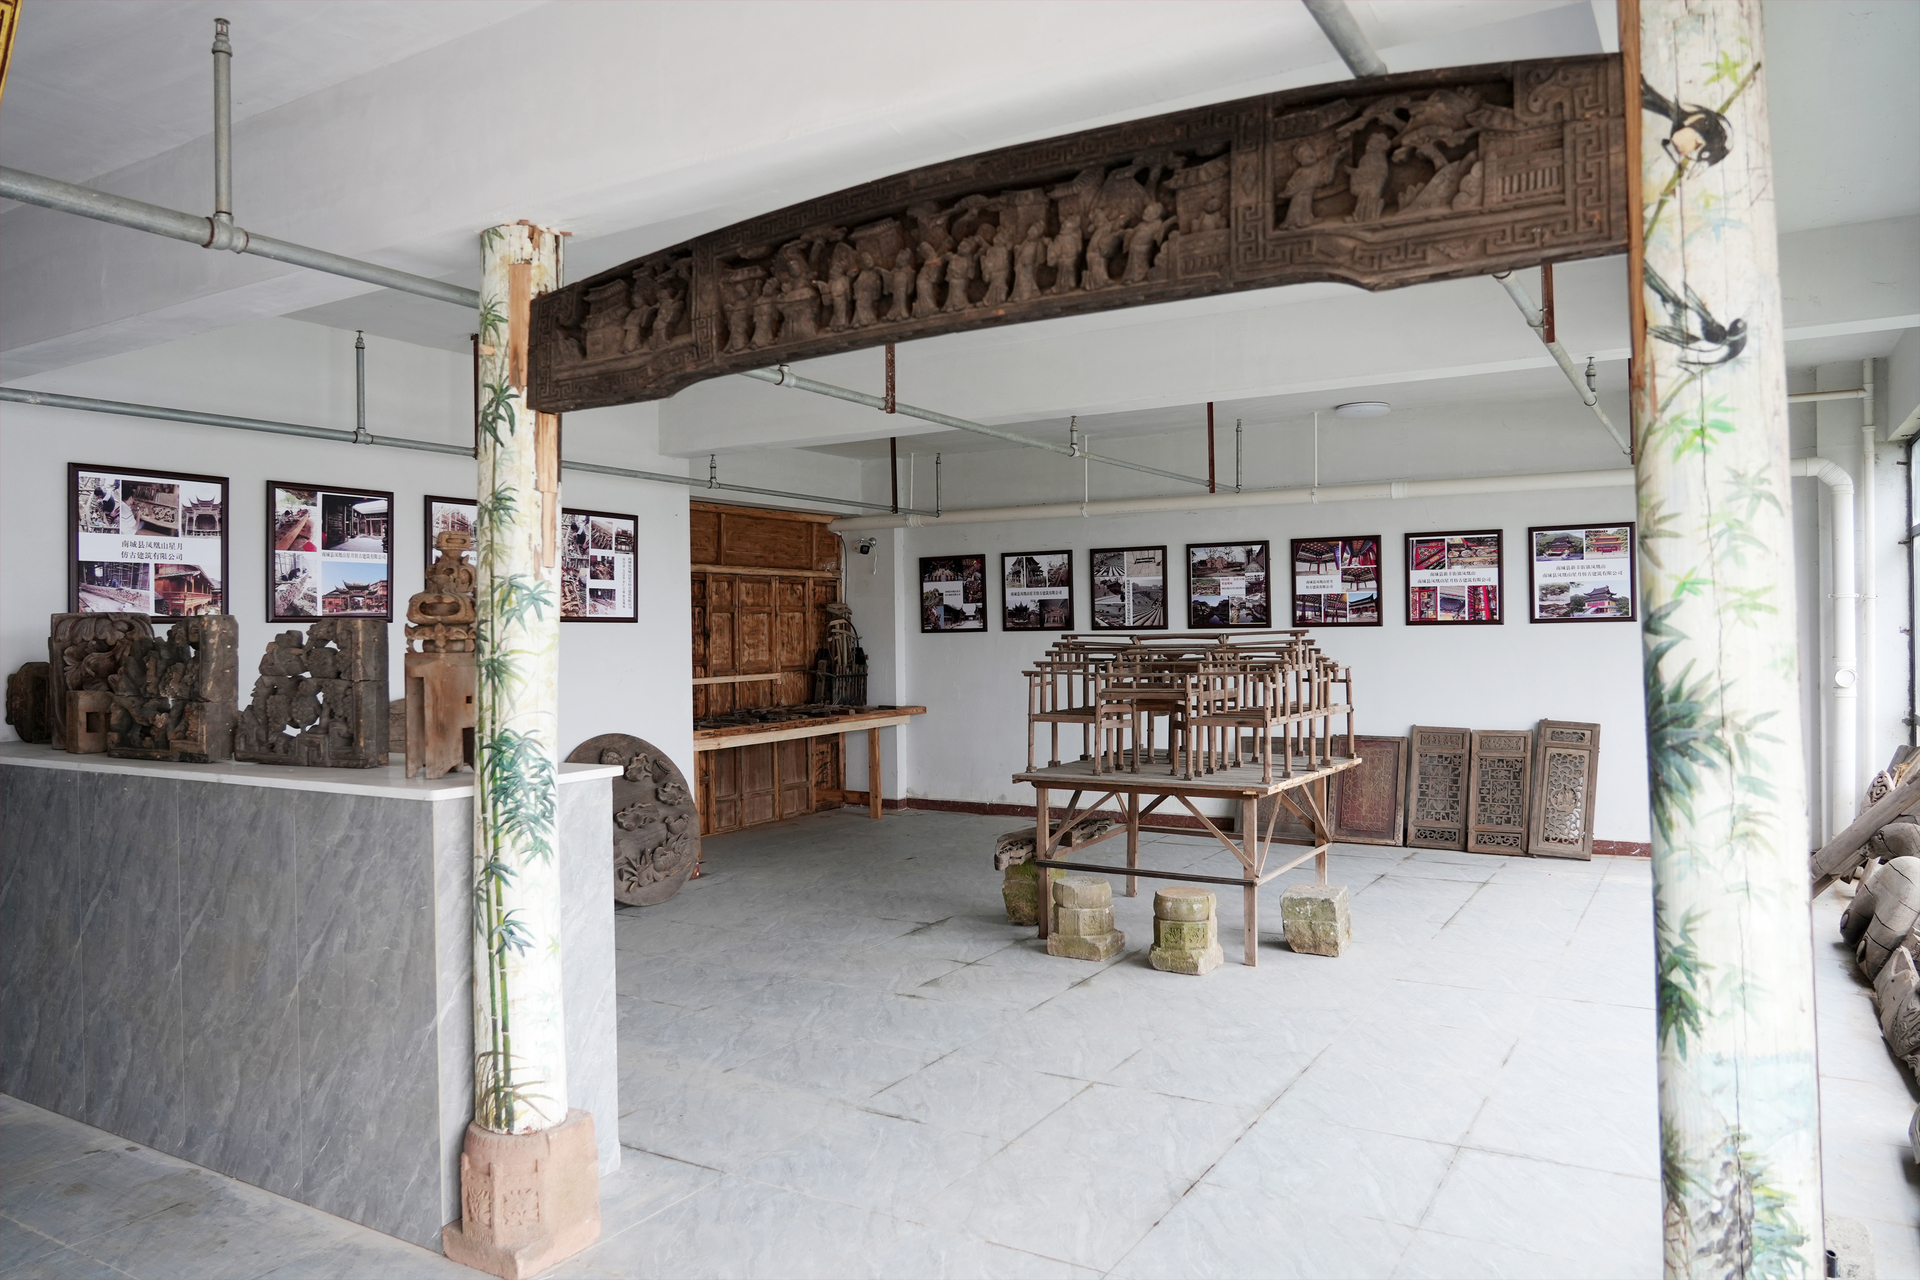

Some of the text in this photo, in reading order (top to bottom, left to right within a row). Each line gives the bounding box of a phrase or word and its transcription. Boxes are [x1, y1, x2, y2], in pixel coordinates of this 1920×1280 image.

[121, 540, 183, 550] 南城县凤凰山星月
[121, 551, 183, 561] 仿古建筑有限公司
[1542, 570, 1623, 578] 南城县凤凰山星月仿古建筑有限公司
